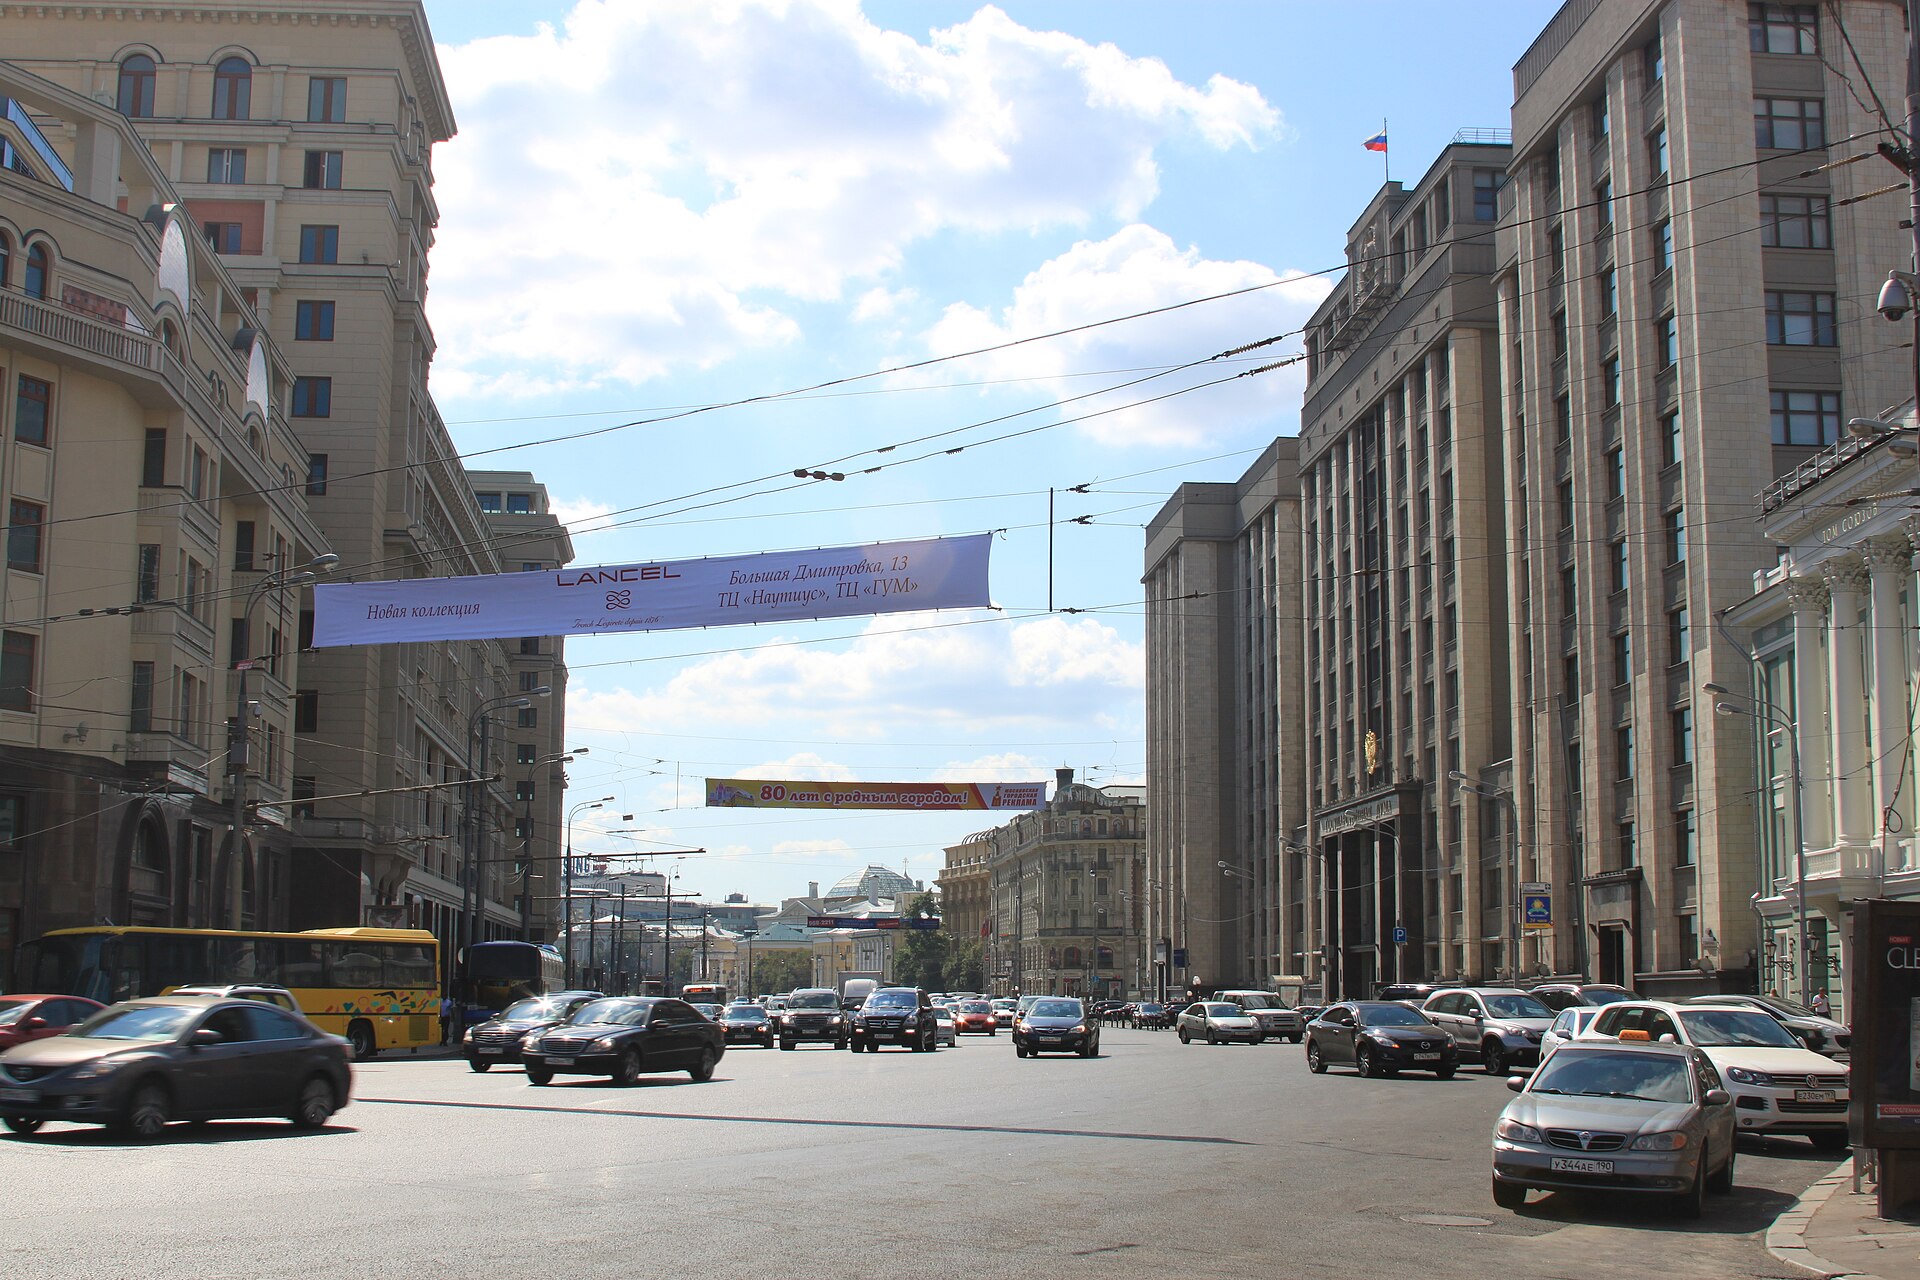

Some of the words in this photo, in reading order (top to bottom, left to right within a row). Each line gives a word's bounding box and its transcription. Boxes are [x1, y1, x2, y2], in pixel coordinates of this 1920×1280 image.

[556, 566, 682, 587] LANCEL
[729, 565, 790, 586] Большая
[792, 558, 885, 583] Дмитровка,
[889, 555, 908, 572] 13
[718, 591, 739, 608] ТЦ
[835, 580, 859, 599] ТЦ
[863, 577, 919, 597] «ГУМ»
[366, 604, 408, 620] Новая
[411, 603, 481, 620] коллекция
[760, 784, 787, 801] 80
[789, 790, 820, 802] лет
[823, 791, 833, 802] с
[834, 789, 898, 806] родным
[900, 790, 969, 807] городом!
[1002, 798, 1037, 806] РЕКЛАМА
[1595, 1161, 1611, 1171] 190
